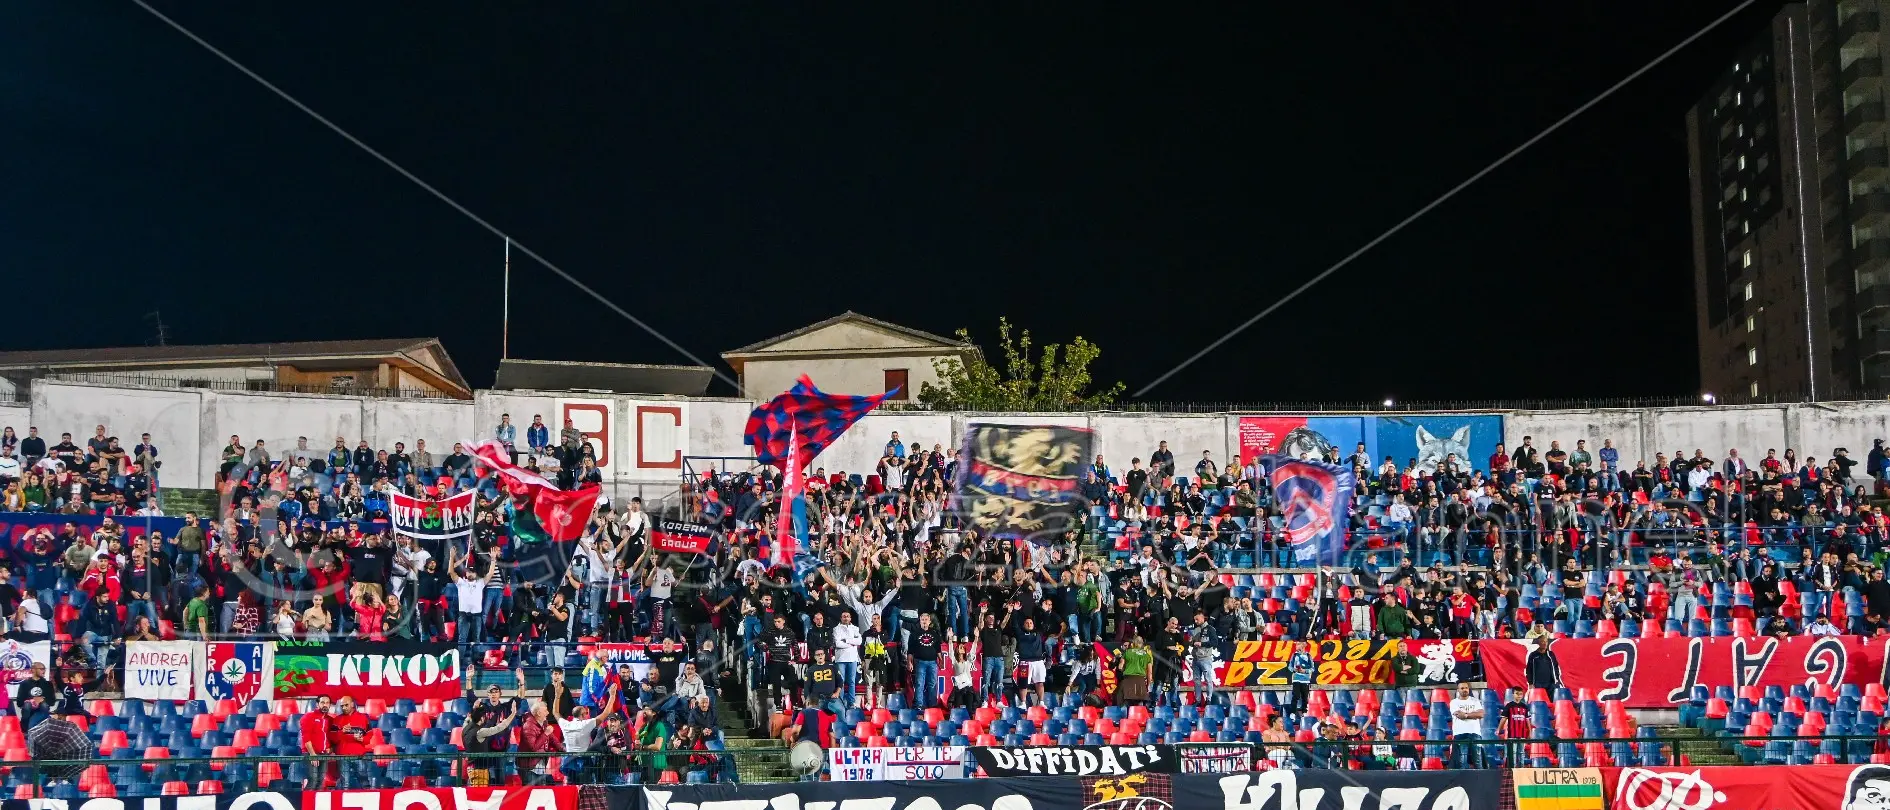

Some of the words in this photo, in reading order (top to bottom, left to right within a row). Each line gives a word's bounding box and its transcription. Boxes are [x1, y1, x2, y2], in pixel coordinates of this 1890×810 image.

[659, 521, 708, 533] KOREAN
[661, 538, 698, 549] GROUP
[129, 651, 189, 667] ANDREA
[138, 669, 179, 687] VIVE
[813, 668, 834, 682] 82
[896, 747, 925, 762] PER
[934, 747, 953, 762] TE
[843, 768, 874, 781] 1978
[905, 765, 944, 780] SOLO
